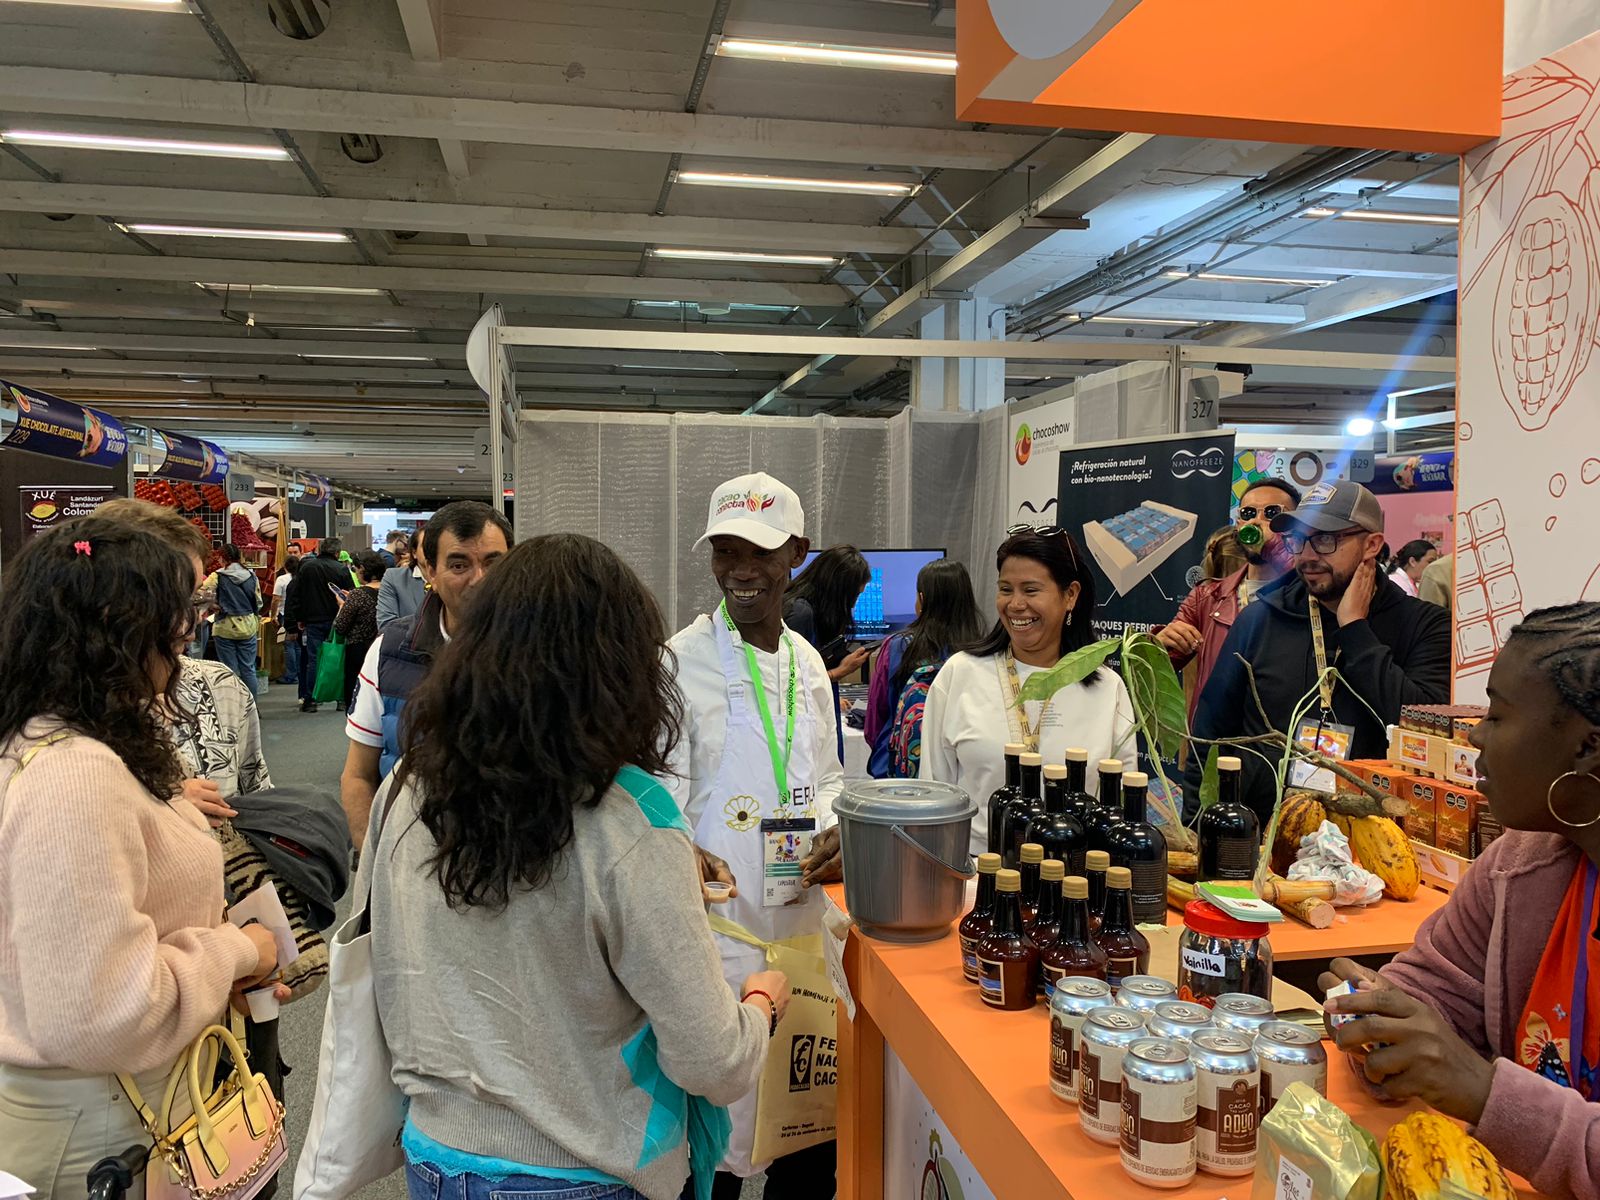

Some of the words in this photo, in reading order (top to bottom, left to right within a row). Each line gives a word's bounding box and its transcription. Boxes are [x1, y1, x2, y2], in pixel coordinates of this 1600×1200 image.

[1191, 400, 1214, 419] 327
[8, 428, 31, 444] 229
[30, 419, 60, 436] CHOCOLATE
[59, 425, 85, 442] ARTESANAL
[1032, 421, 1071, 441] chocoshow
[1070, 458, 1118, 475] ¡Refrigeración
[1119, 455, 1147, 469] natural
[1171, 457, 1224, 468] NANOFREEZE
[1351, 458, 1370, 470] 329
[1070, 475, 1083, 485] con
[1083, 469, 1153, 484] bio-nanotecnología!
[31, 490, 57, 501] XUÉ
[234, 483, 249, 492] 233
[62, 507, 95, 516] Colom
[787, 680, 796, 717] chocoshow
[1183, 955, 1222, 973] Vainilla
[813, 1072, 837, 1086] CAC
[1228, 1101, 1251, 1109] CACAO
